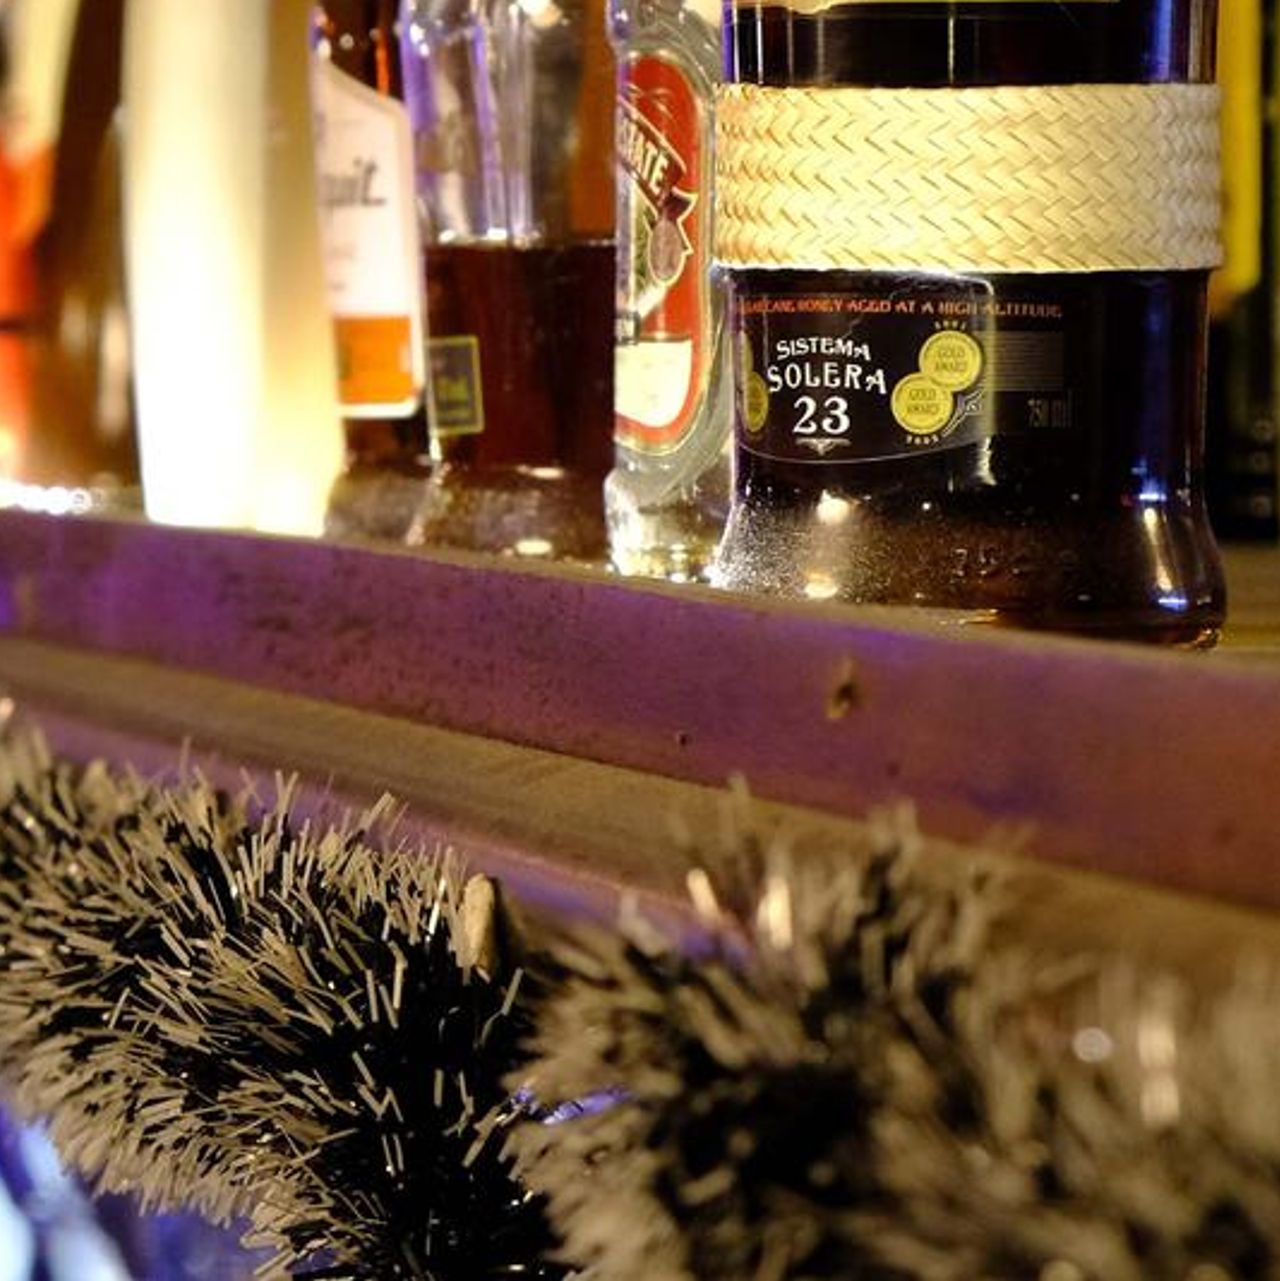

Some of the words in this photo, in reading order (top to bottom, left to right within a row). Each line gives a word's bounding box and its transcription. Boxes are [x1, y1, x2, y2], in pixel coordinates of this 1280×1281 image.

[847, 299, 891, 313] AGED
[894, 300, 916, 314] AT
[921, 300, 935, 315] A
[938, 300, 978, 316] HIGH
[776, 336, 871, 361] SISTEMA
[767, 361, 887, 395] SOLERA
[792, 395, 851, 435] 23
